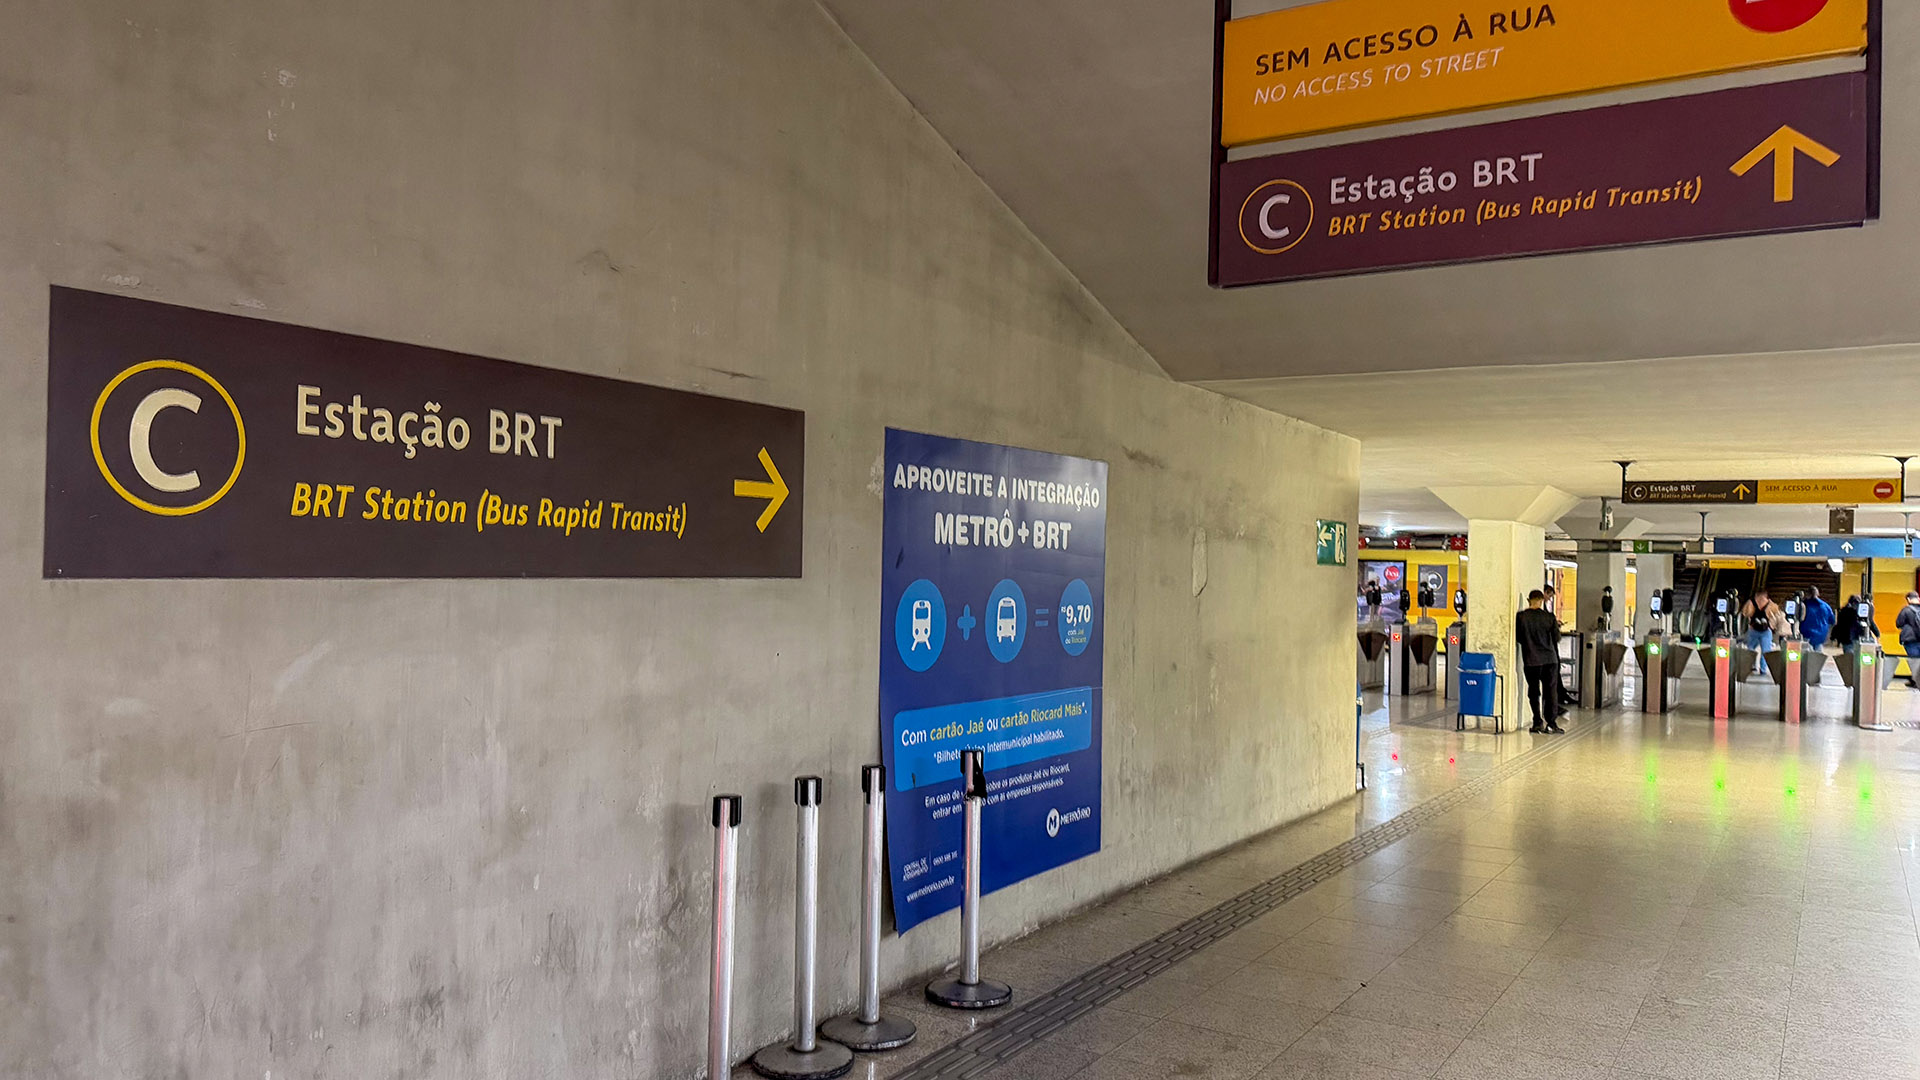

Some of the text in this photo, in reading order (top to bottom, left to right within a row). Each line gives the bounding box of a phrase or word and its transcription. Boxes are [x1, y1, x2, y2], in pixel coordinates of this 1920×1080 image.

[1256, 3, 1557, 78] SEM ACESSO À RUA
[1253, 46, 1504, 106] NO ACCESS TO STREET
[1330, 153, 1543, 207] Estação BRT
[1258, 194, 1291, 241] C
[1327, 175, 1702, 238] BRT Station (Bus Rapid Transit)
[129, 387, 203, 493] C
[296, 384, 563, 460] Estação BRT
[290, 481, 688, 541] BRT Station (Bus Rapid Transit)
[893, 463, 1100, 512] APROVEITE A INTEGRAÇÃO
[1633, 487, 1642, 498] C
[1649, 484, 1697, 493] Estação BRT
[1793, 541, 1819, 553] BRT
[901, 729, 927, 747] Com
[930, 721, 964, 742] cartão
[967, 717, 984, 735] Jaé
[986, 718, 999, 732] ou
[1000, 711, 1029, 729] cartão
[1030, 705, 1063, 722] Riocard
[986, 735, 1033, 754] Intermunicipal
[924, 795, 936, 808] Em
[936, 792, 951, 806] caso
[952, 790, 960, 800] de
[932, 806, 951, 820] entrar
[951, 803, 962, 814] em
